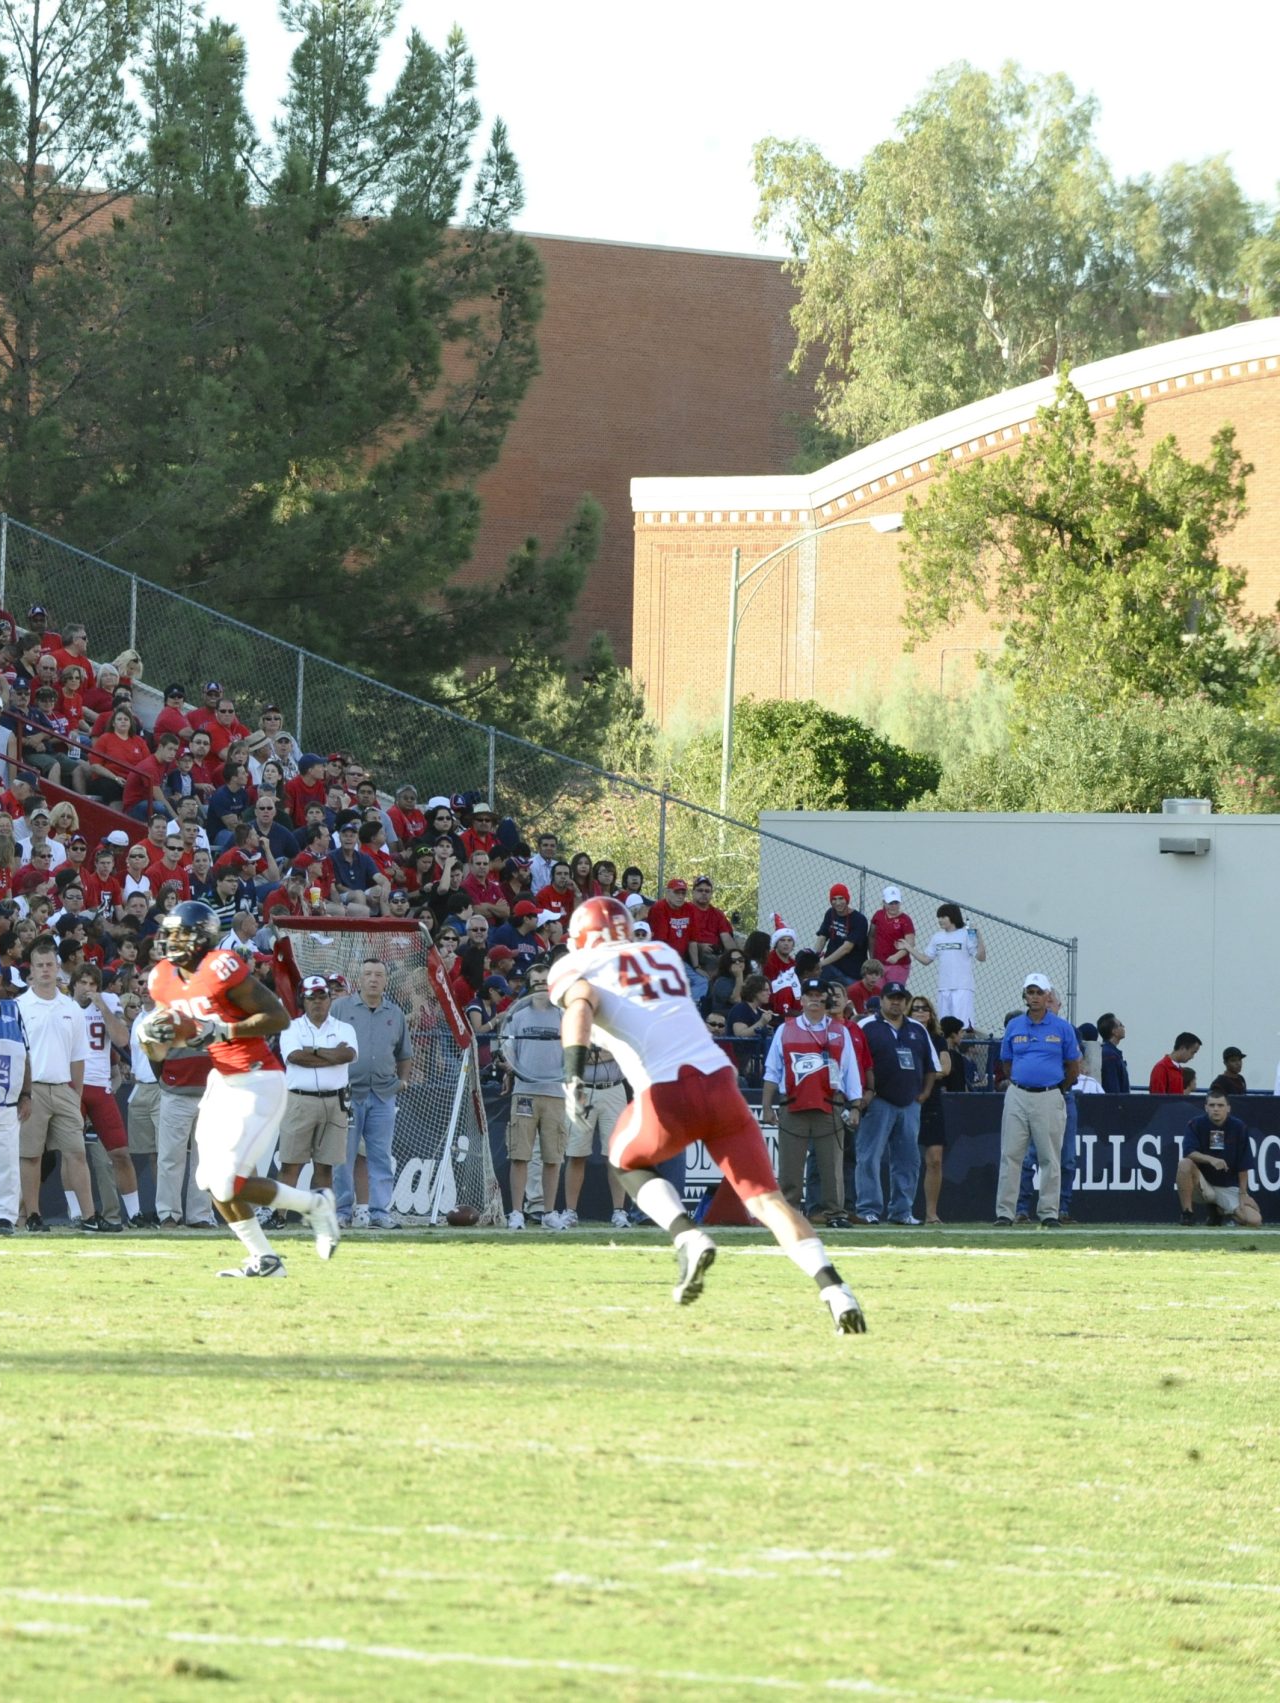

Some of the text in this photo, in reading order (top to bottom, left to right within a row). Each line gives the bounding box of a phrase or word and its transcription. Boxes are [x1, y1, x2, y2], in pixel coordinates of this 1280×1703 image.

[209, 953, 239, 981] 26
[618, 950, 687, 1002] 45
[90, 1022, 105, 1051] 9
[1072, 1134, 1163, 1192] LLS
